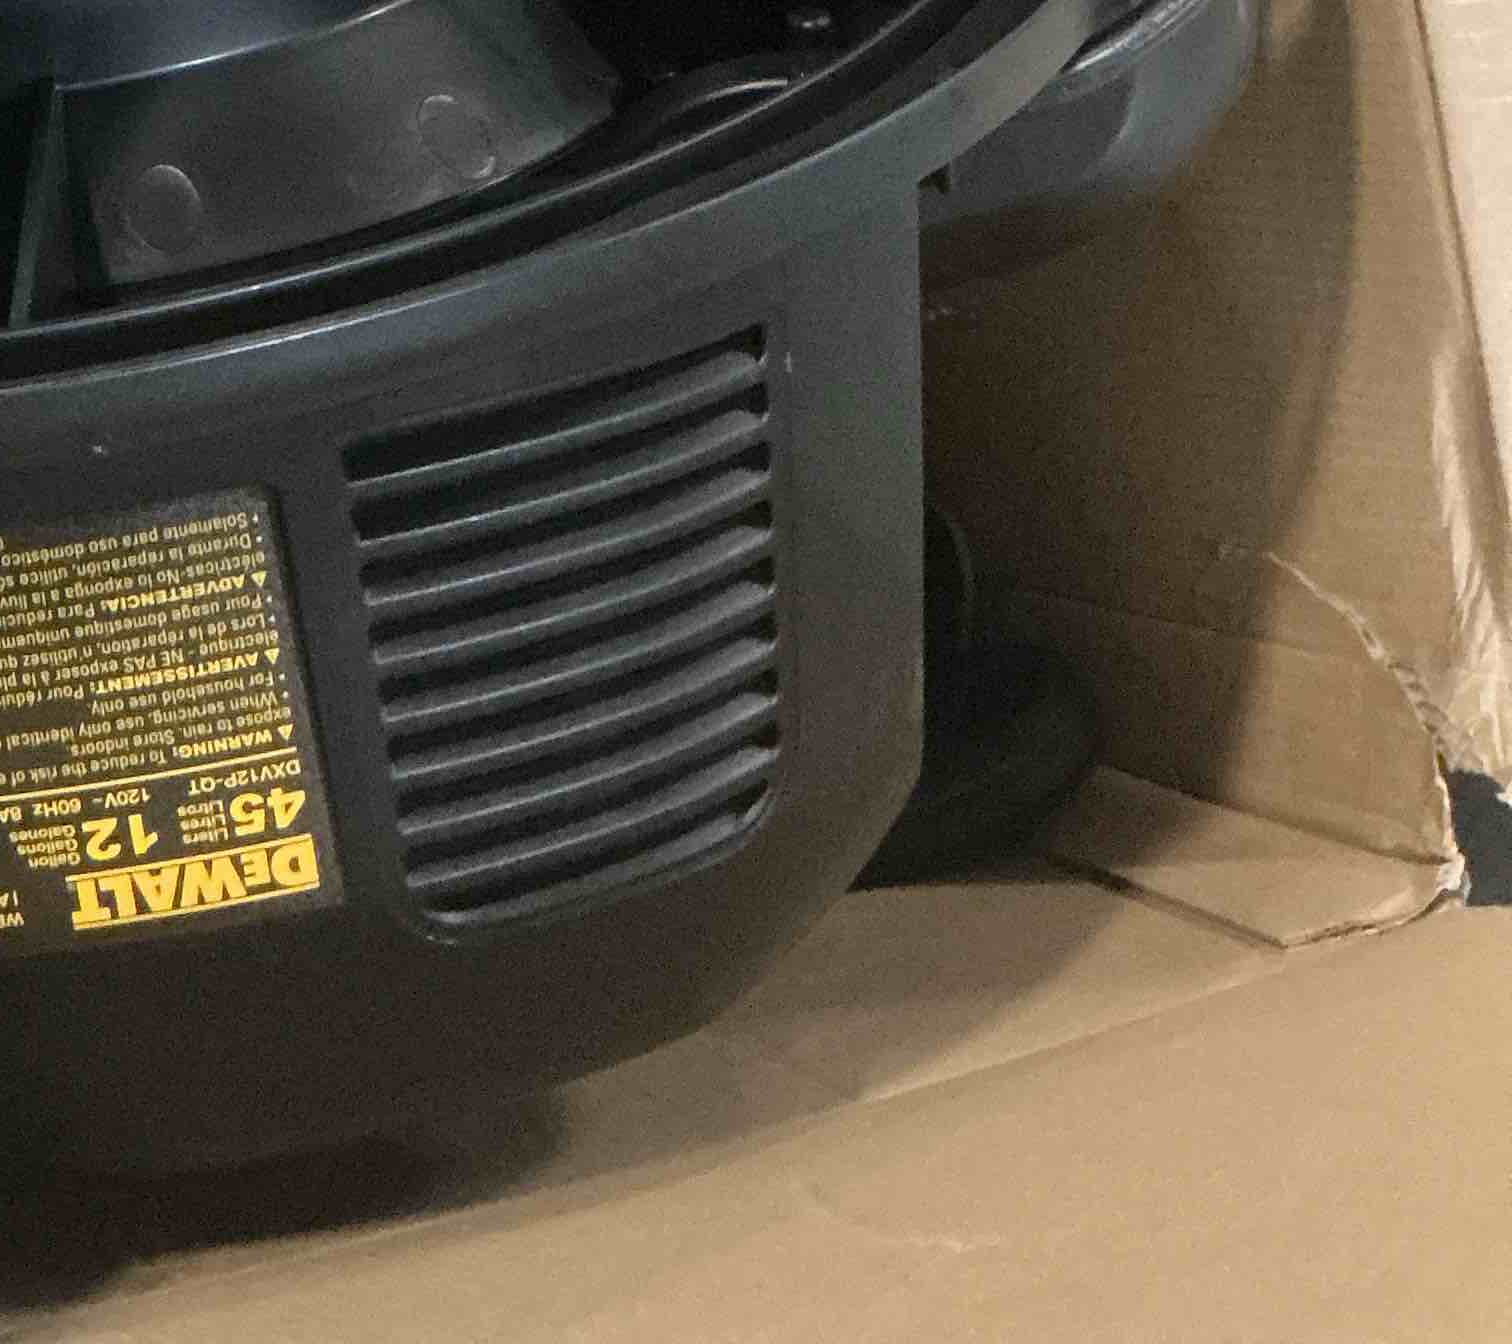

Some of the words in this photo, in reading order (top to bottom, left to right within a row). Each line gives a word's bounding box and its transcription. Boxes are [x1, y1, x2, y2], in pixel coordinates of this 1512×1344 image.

[163, 512, 248, 540] Solamente
[88, 537, 118, 553] uso
[122, 527, 159, 548] para
[187, 532, 252, 556] Durante
[168, 546, 184, 562] la
[19, 567, 69, 586] utilice
[137, 573, 153, 589] lo
[50, 588, 60, 602] a
[64, 576, 134, 599] exponga
[100, 574, 245, 612] ADVERTENCIA:
[31, 591, 47, 606] la
[225, 593, 263, 611] Pour
[57, 602, 95, 619] Para
[171, 601, 220, 621] usage
[74, 611, 168, 638] domestique
[207, 621, 228, 637] de
[230, 612, 266, 631] Lors
[96, 629, 184, 655] réparation,
[188, 625, 204, 641] la
[123, 653, 157, 674] PAS
[160, 648, 185, 667] NE
[55, 659, 119, 681] exposer
[90, 652, 258, 694] AVERTISSEMENT:
[248, 671, 275, 687] For
[21, 672, 37, 688] la
[46, 684, 85, 700] Pour
[128, 693, 158, 709] use
[161, 677, 245, 706] household
[229, 690, 278, 711] When
[115, 715, 145, 731] use
[216, 718, 234, 732] to
[236, 704, 292, 727] expose
[6, 727, 75, 751] identical
[78, 720, 112, 739] only
[132, 728, 175, 747] Store
[178, 722, 213, 740] rain.
[70, 737, 130, 757] indoors.
[172, 729, 273, 759] WARNING:
[90, 752, 145, 772] reduce
[149, 749, 167, 766] To
[11, 770, 26, 787] of
[28, 766, 58, 783] risk
[61, 761, 88, 778] the
[188, 759, 301, 796] DXV12P-QT
[32, 797, 82, 818] 60Hz
[177, 799, 225, 817] Litros
[229, 787, 306, 837] 45
[180, 812, 227, 831] Litres
[9, 824, 76, 842] Galones
[81, 813, 158, 861] 12
[182, 826, 229, 845] Liters
[17, 837, 78, 855] Gallons
[28, 851, 81, 868] Gallon
